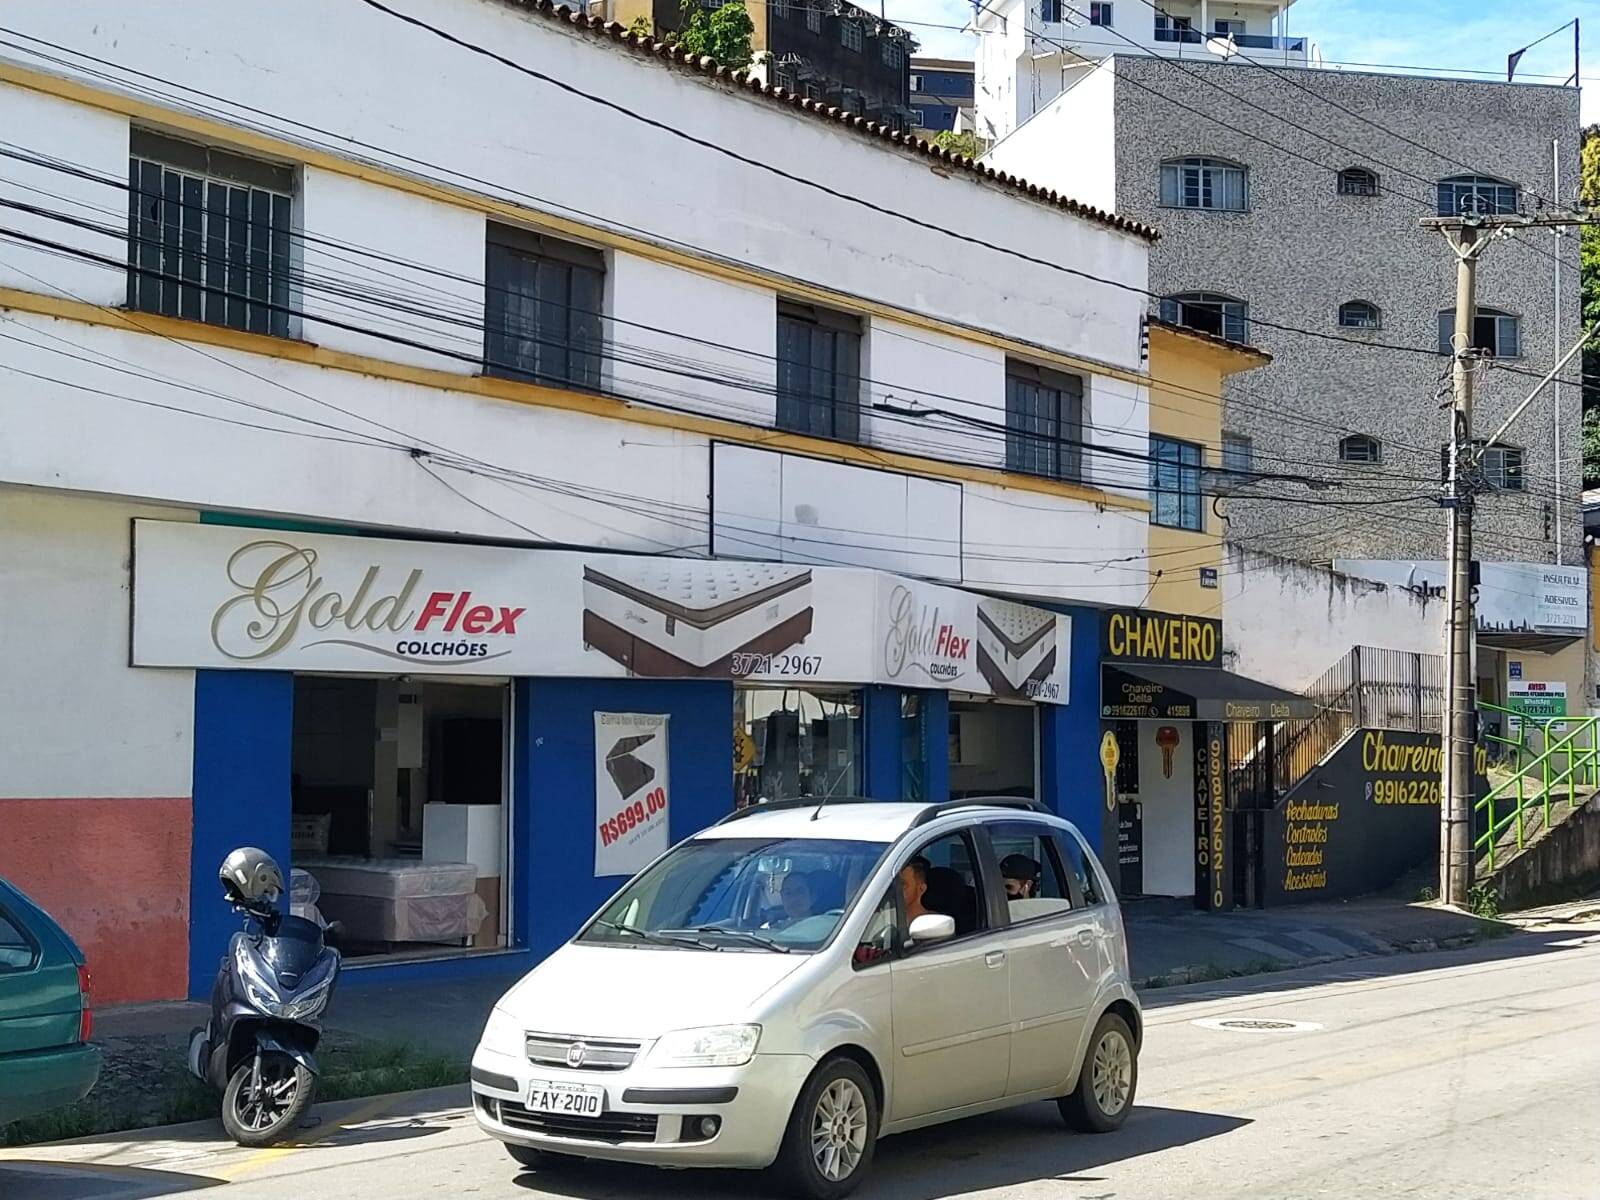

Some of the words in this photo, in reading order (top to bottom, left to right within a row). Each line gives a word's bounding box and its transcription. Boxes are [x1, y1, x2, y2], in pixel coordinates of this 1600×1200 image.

[211, 540, 423, 660] Gold
[414, 591, 527, 634] Flex
[396, 639, 488, 656] COLCHÕES
[885, 585, 939, 678] Gold
[936, 625, 970, 660] Flex
[1109, 614, 1216, 662] CHAVEIRO
[731, 653, 822, 675] 3721-2967
[930, 663, 958, 676] COLCHÕES
[600, 787, 666, 847] R$699,00
[1197, 749, 1208, 865] CHAVEIRO
[1211, 740, 1223, 907] 998526210
